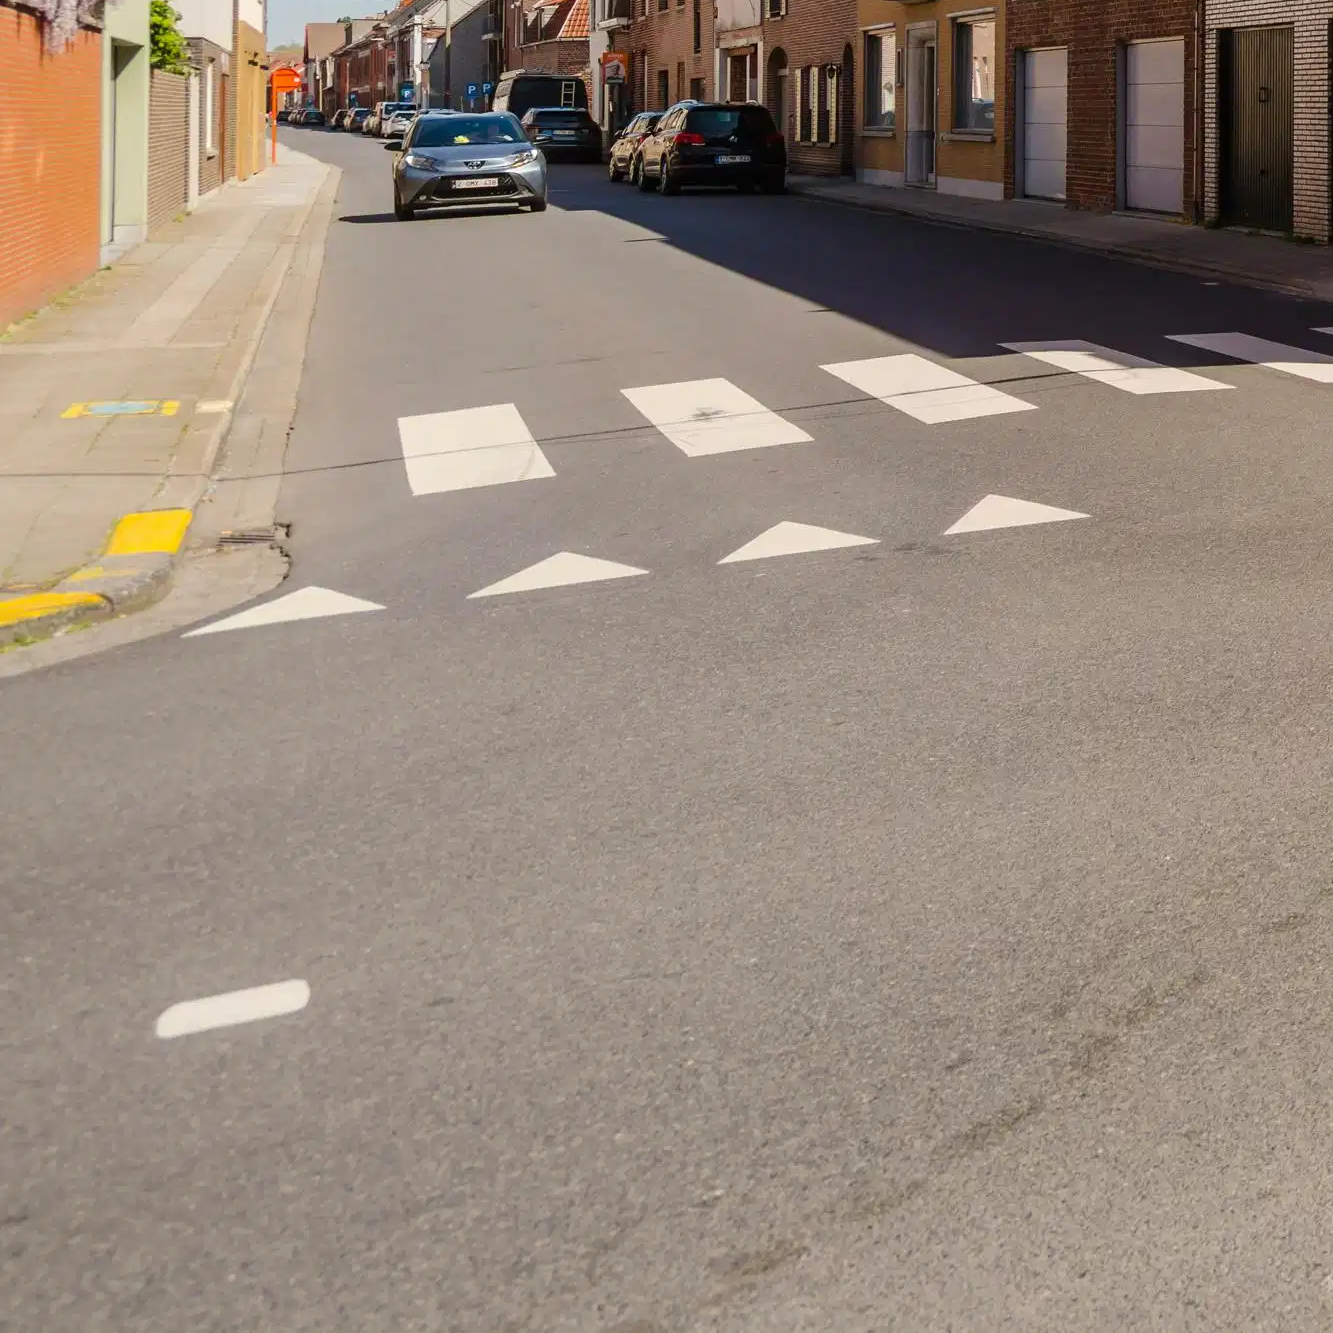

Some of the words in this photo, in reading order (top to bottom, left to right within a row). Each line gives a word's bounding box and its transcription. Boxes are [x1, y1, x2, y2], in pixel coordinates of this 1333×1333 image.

[468, 85, 476, 94] P
[482, 83, 491, 92] P
[404, 90, 410, 98] P
